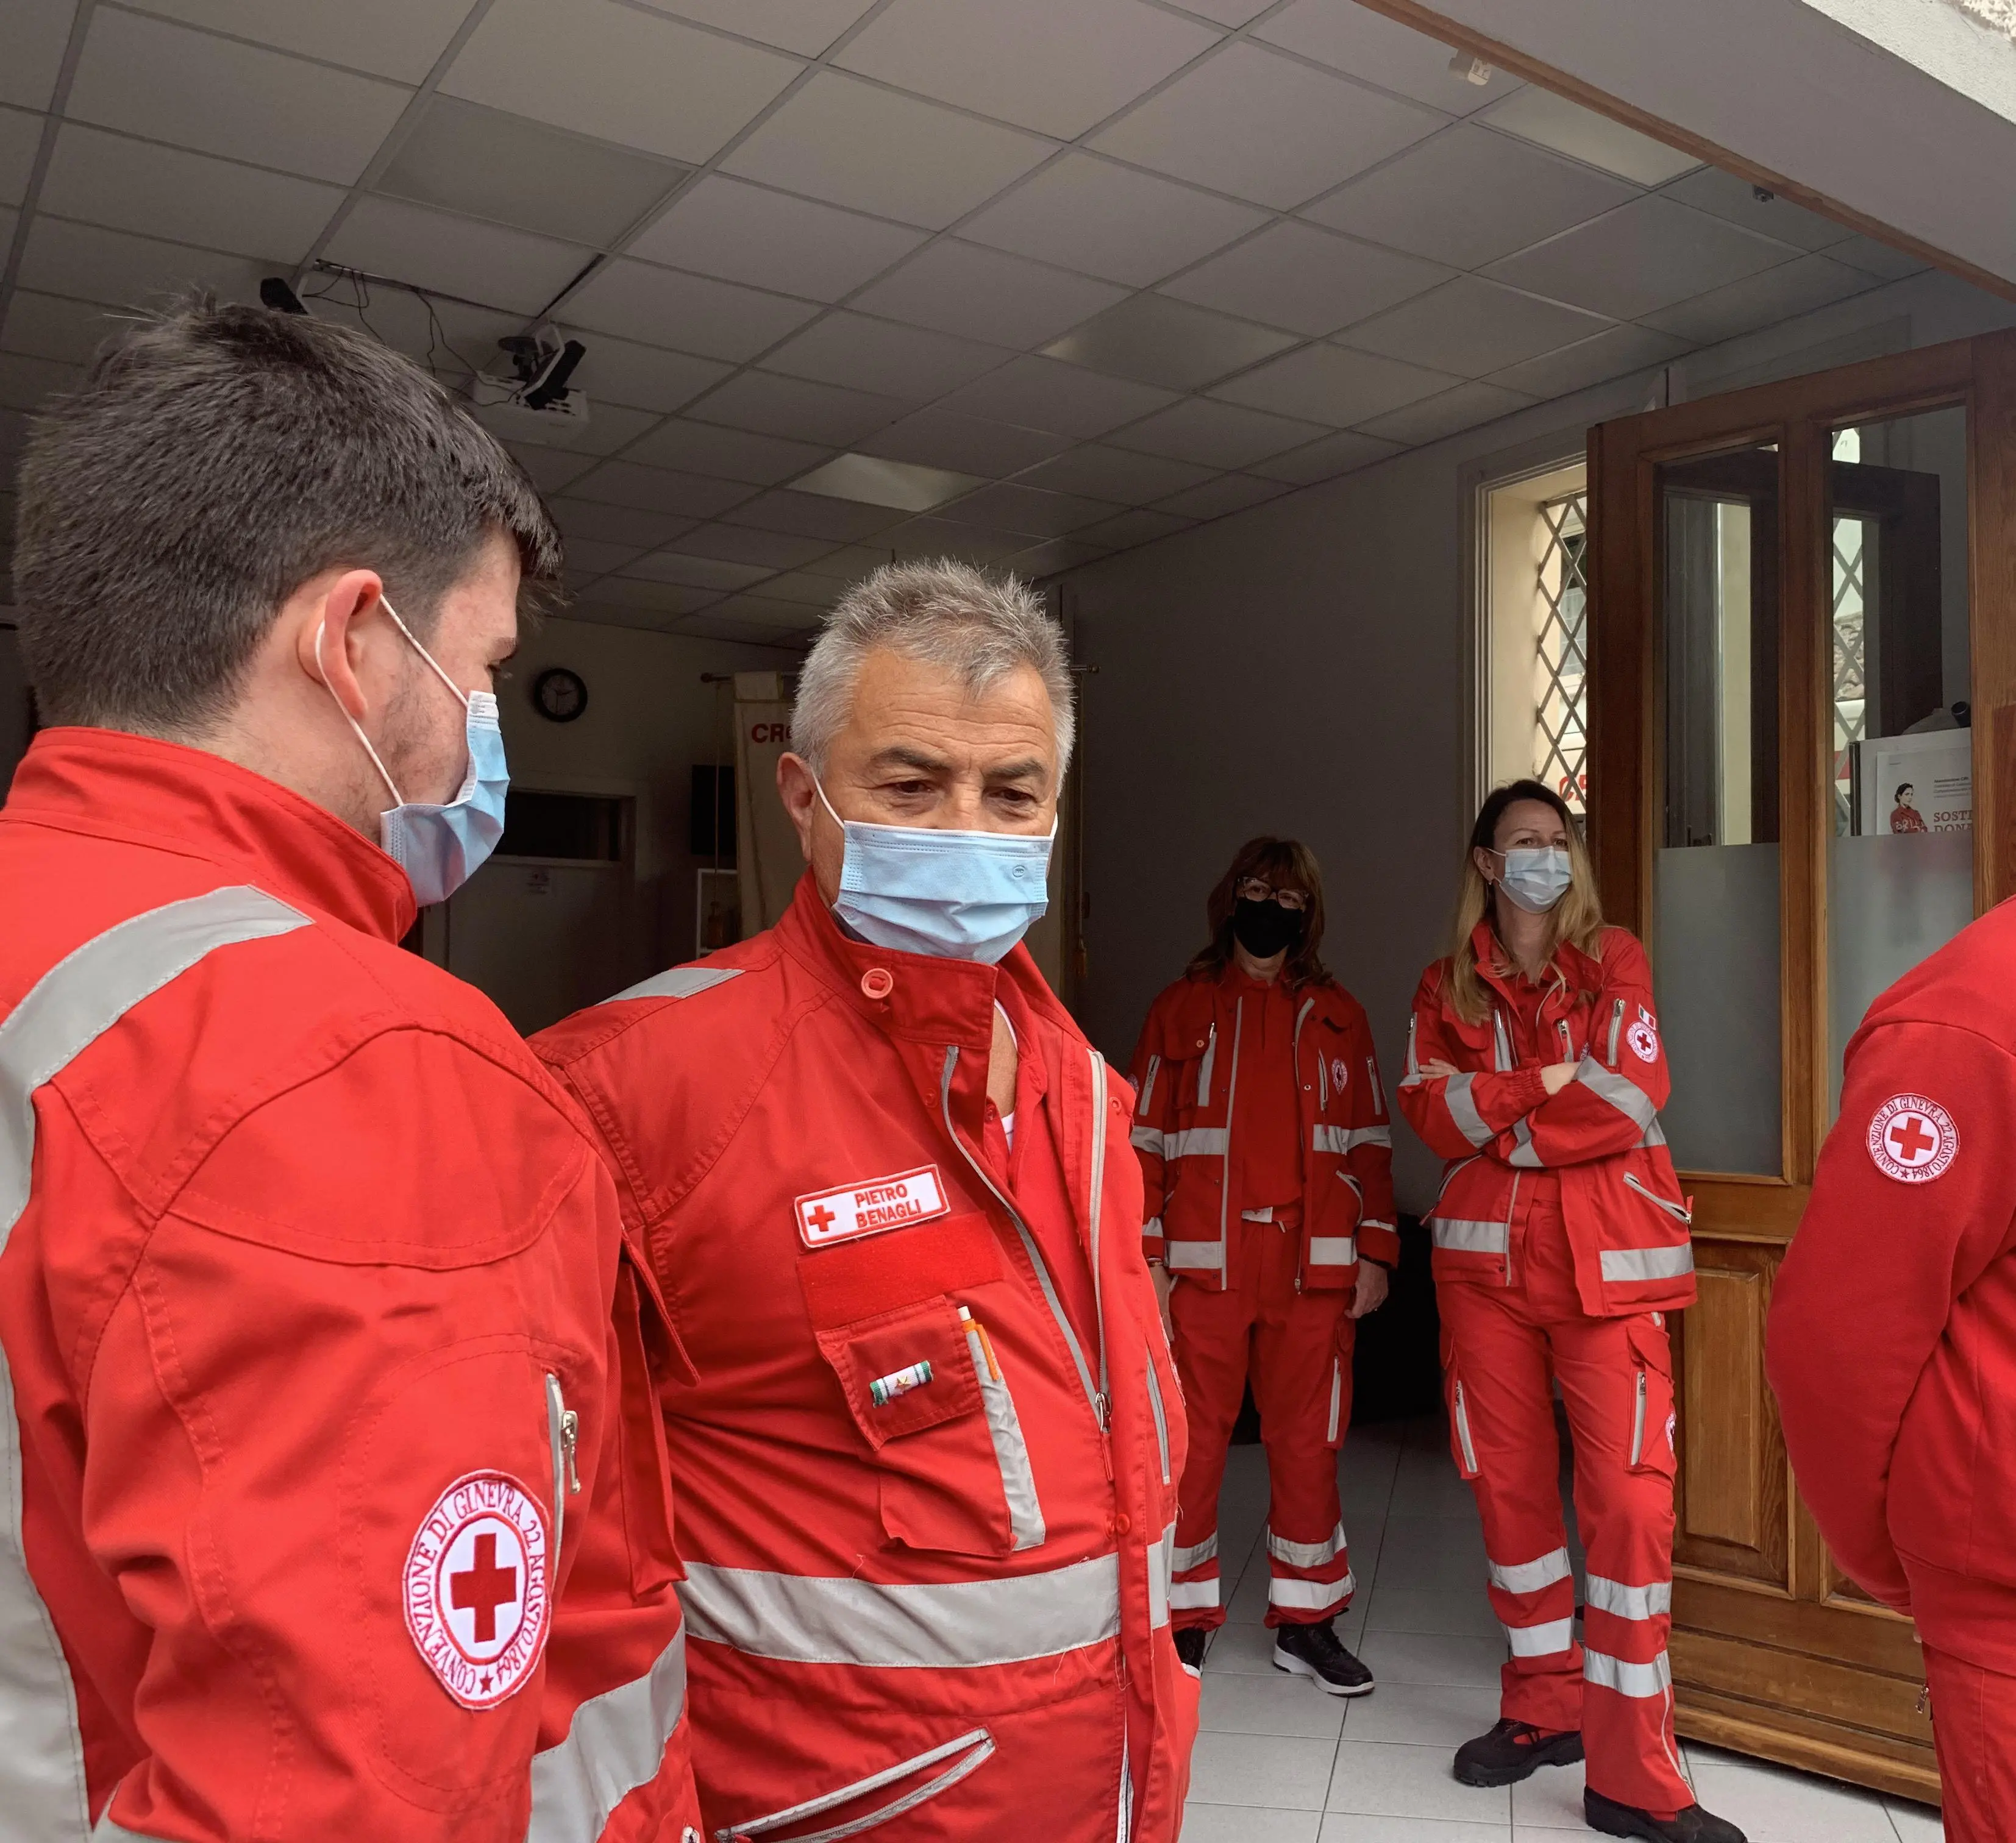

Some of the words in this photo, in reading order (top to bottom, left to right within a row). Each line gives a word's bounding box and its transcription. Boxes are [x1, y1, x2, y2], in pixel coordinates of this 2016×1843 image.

[1887, 1101, 1898, 1115] DI
[1900, 1096, 1942, 1123] GINEVRA
[1871, 1110, 1900, 1174] CONVENZIONE
[1940, 1122, 1952, 1134] 22
[1933, 1135, 1954, 1171] AGOSTO
[1912, 1166, 1934, 1180] 1864
[854, 1183, 908, 1208] PIETRO
[855, 1199, 922, 1228] BENAGLI
[454, 1480, 525, 1526] GINEVRA
[427, 1511, 456, 1546] DI
[522, 1520, 541, 1549] 22
[521, 1554, 545, 1645] AGOSTO
[410, 1542, 476, 1694] CONVENZIONE
[496, 1641, 527, 1685] 1864
